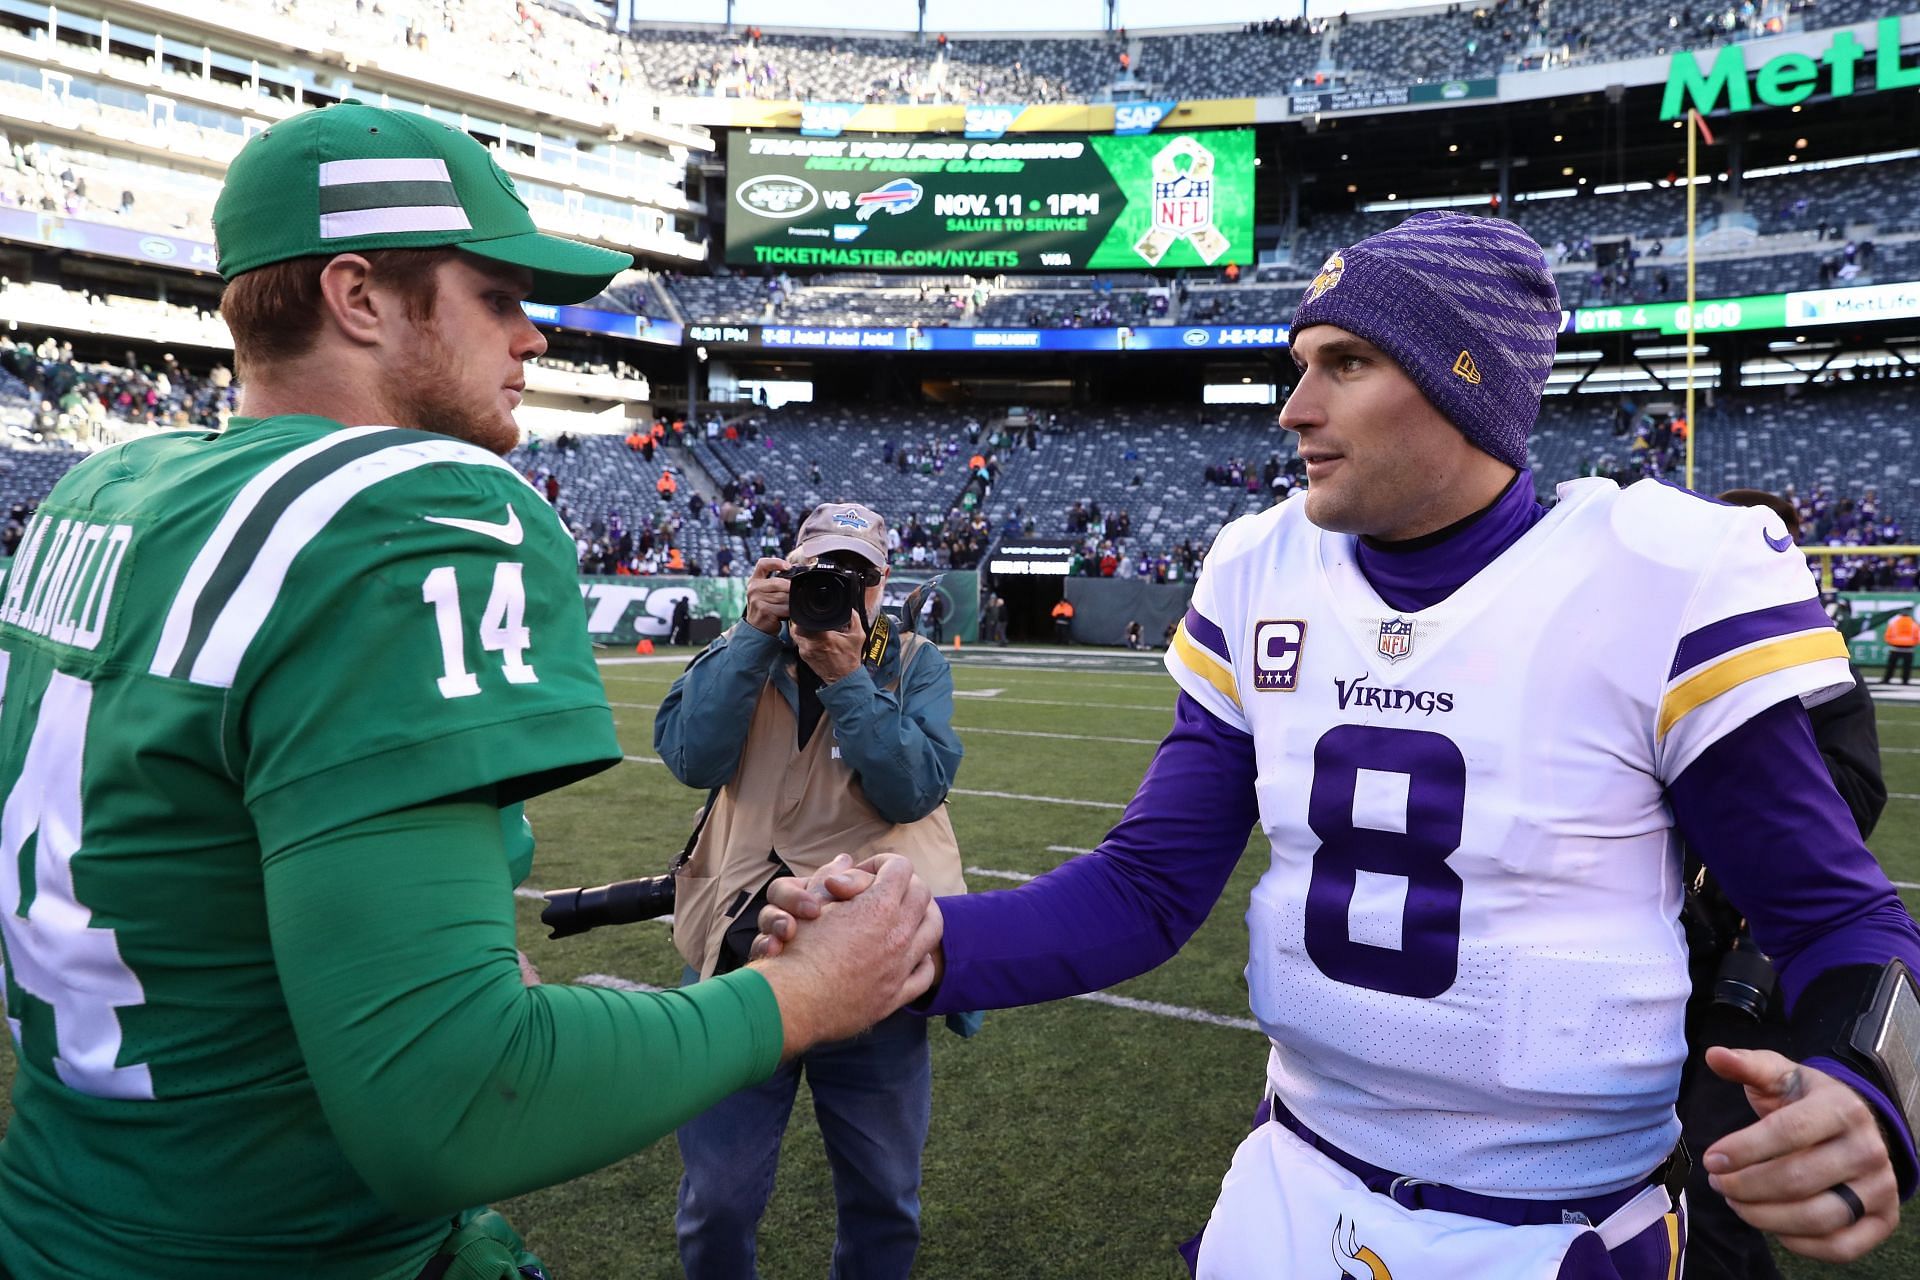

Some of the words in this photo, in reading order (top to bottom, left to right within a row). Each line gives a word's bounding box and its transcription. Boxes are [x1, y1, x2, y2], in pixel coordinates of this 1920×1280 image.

[1660, 16, 1920, 121] MetL
[802, 105, 849, 130] SAP
[965, 108, 1013, 131] SAP
[1115, 106, 1162, 129] SAP
[749, 138, 848, 157] THANK
[849, 142, 909, 158] YOU
[907, 142, 968, 159] FOR
[969, 142, 1084, 159] COMING
[804, 157, 871, 171] NEXT
[869, 158, 945, 172] HOME
[934, 194, 990, 216] NOV.
[995, 194, 1022, 216] 11
[1046, 193, 1099, 215] 1PM
[1162, 201, 1203, 226] NFL
[946, 217, 1003, 231] SALUTE
[1005, 218, 1025, 231] TO
[1026, 218, 1088, 232] SERVICE
[754, 246, 1019, 267] TICKETMASTER.COM/NYJETS
[1040, 253, 1071, 265] VISA
[1835, 295, 1919, 313] MetLife
[1580, 310, 1622, 329] QTR
[1632, 308, 1647, 326] 4
[723, 328, 749, 341] PM
[1002, 333, 1037, 345] LIGHT
[579, 584, 699, 636] TS
[423, 562, 538, 699] 14
[869, 638, 882, 660] Nikon
[1257, 623, 1300, 671] C
[1381, 635, 1407, 655] NFL
[1304, 723, 1467, 999] 8
